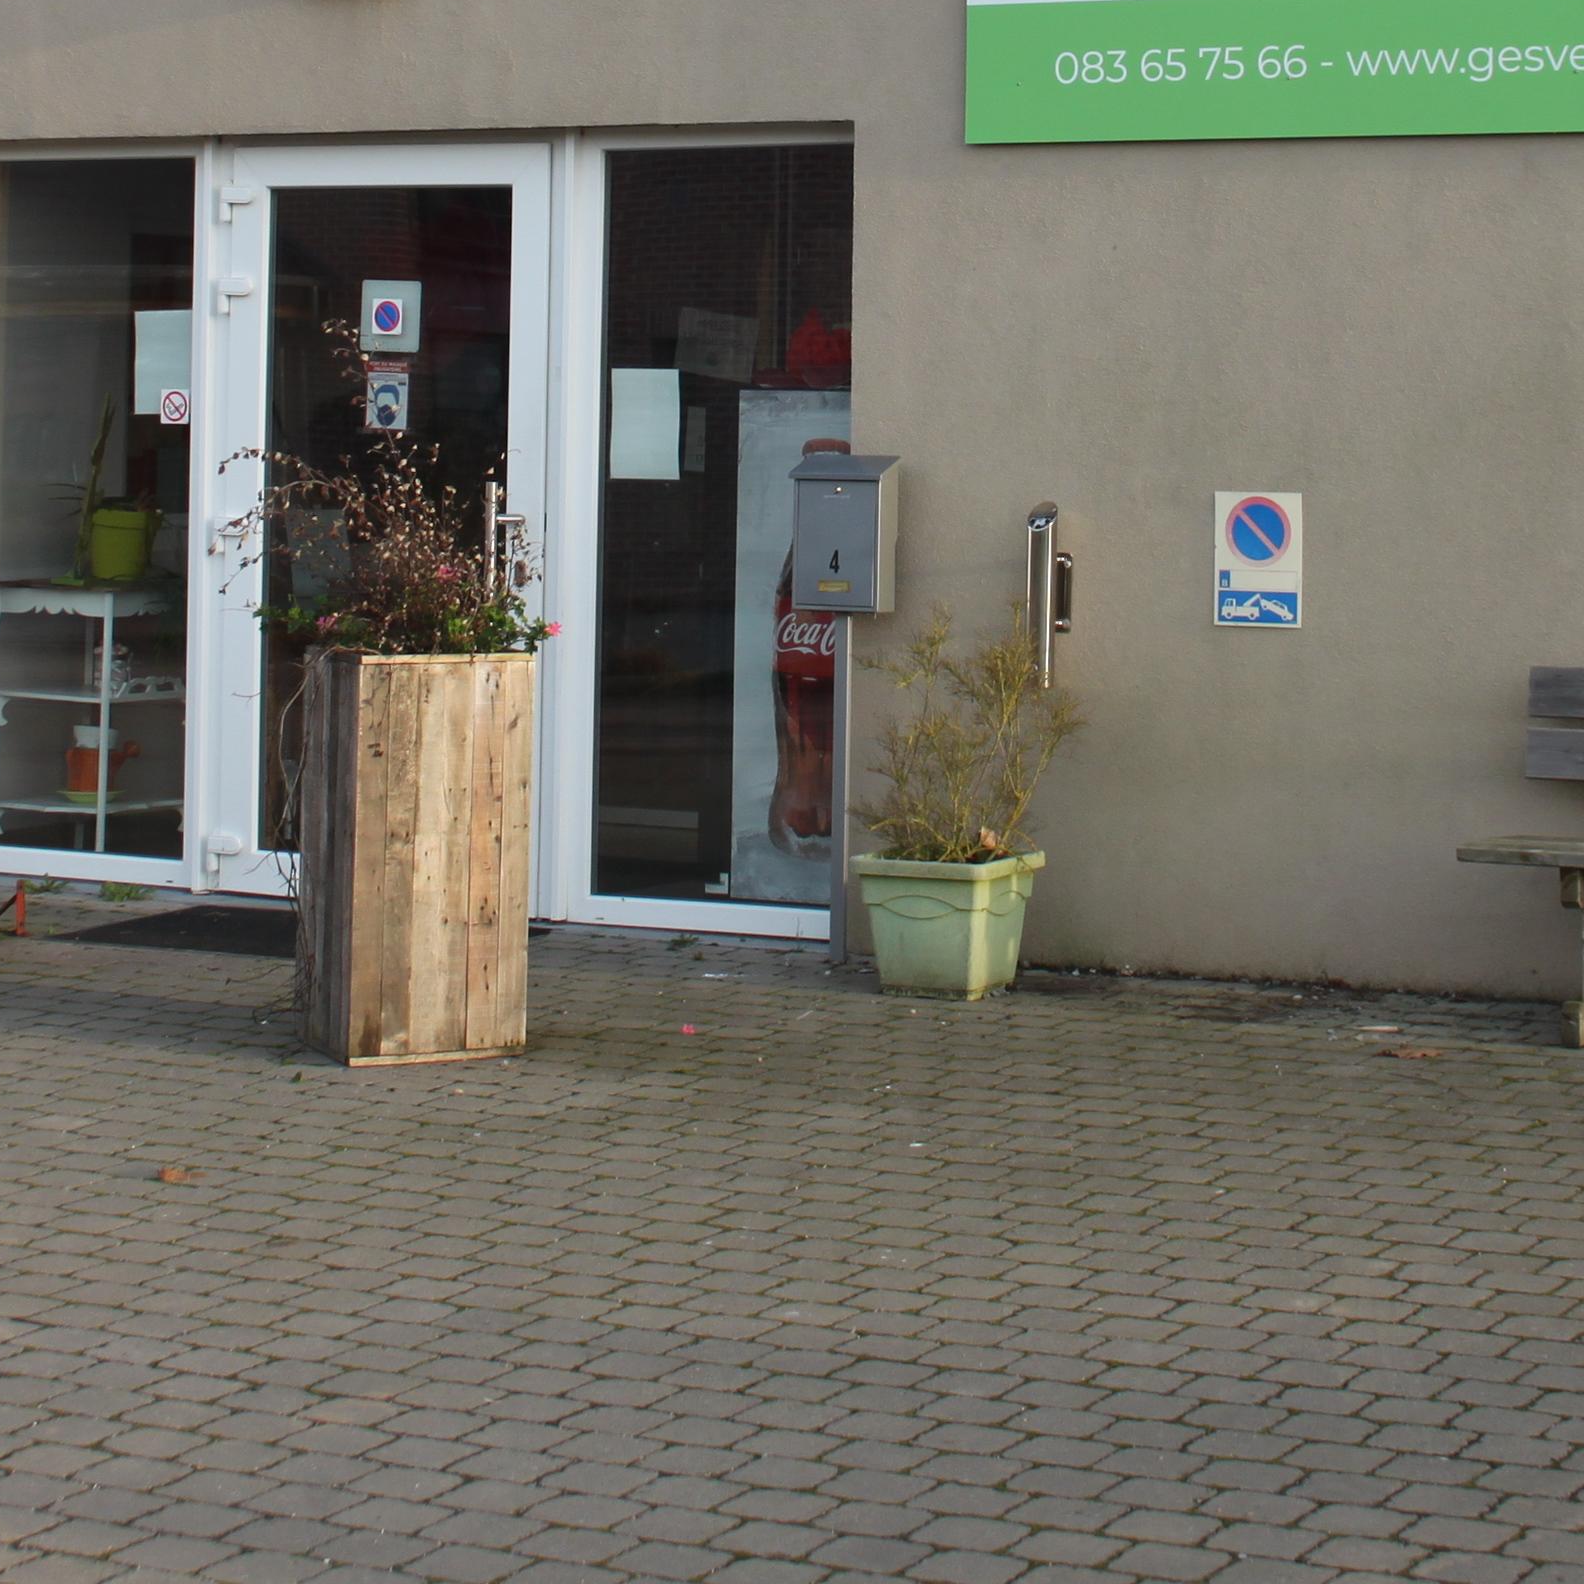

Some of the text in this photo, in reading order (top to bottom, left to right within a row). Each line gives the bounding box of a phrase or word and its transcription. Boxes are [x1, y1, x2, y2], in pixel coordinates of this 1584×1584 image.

[1054, 50, 1129, 85] 083
[1139, 48, 1188, 83] 65
[1198, 46, 1246, 81] 75
[1257, 44, 1308, 79] 66
[829, 549, 840, 574] 4
